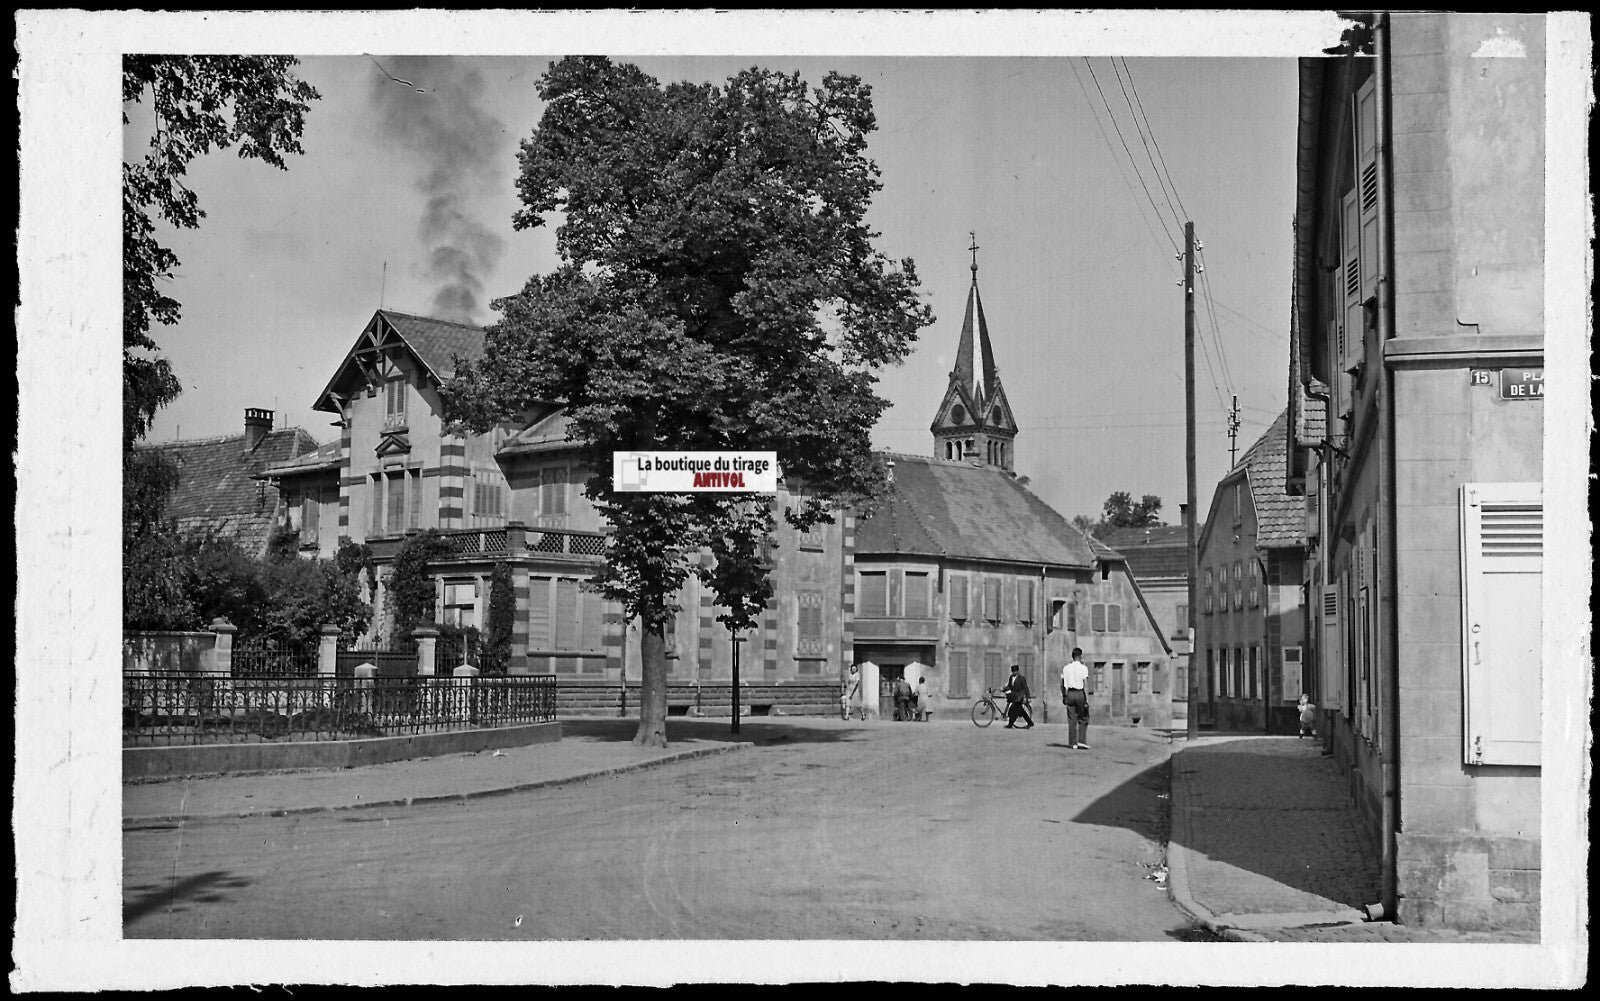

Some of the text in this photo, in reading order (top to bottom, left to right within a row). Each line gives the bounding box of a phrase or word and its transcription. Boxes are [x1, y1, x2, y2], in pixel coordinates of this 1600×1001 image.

[1474, 371, 1489, 383] 15
[1510, 384, 1544, 395] DE LA
